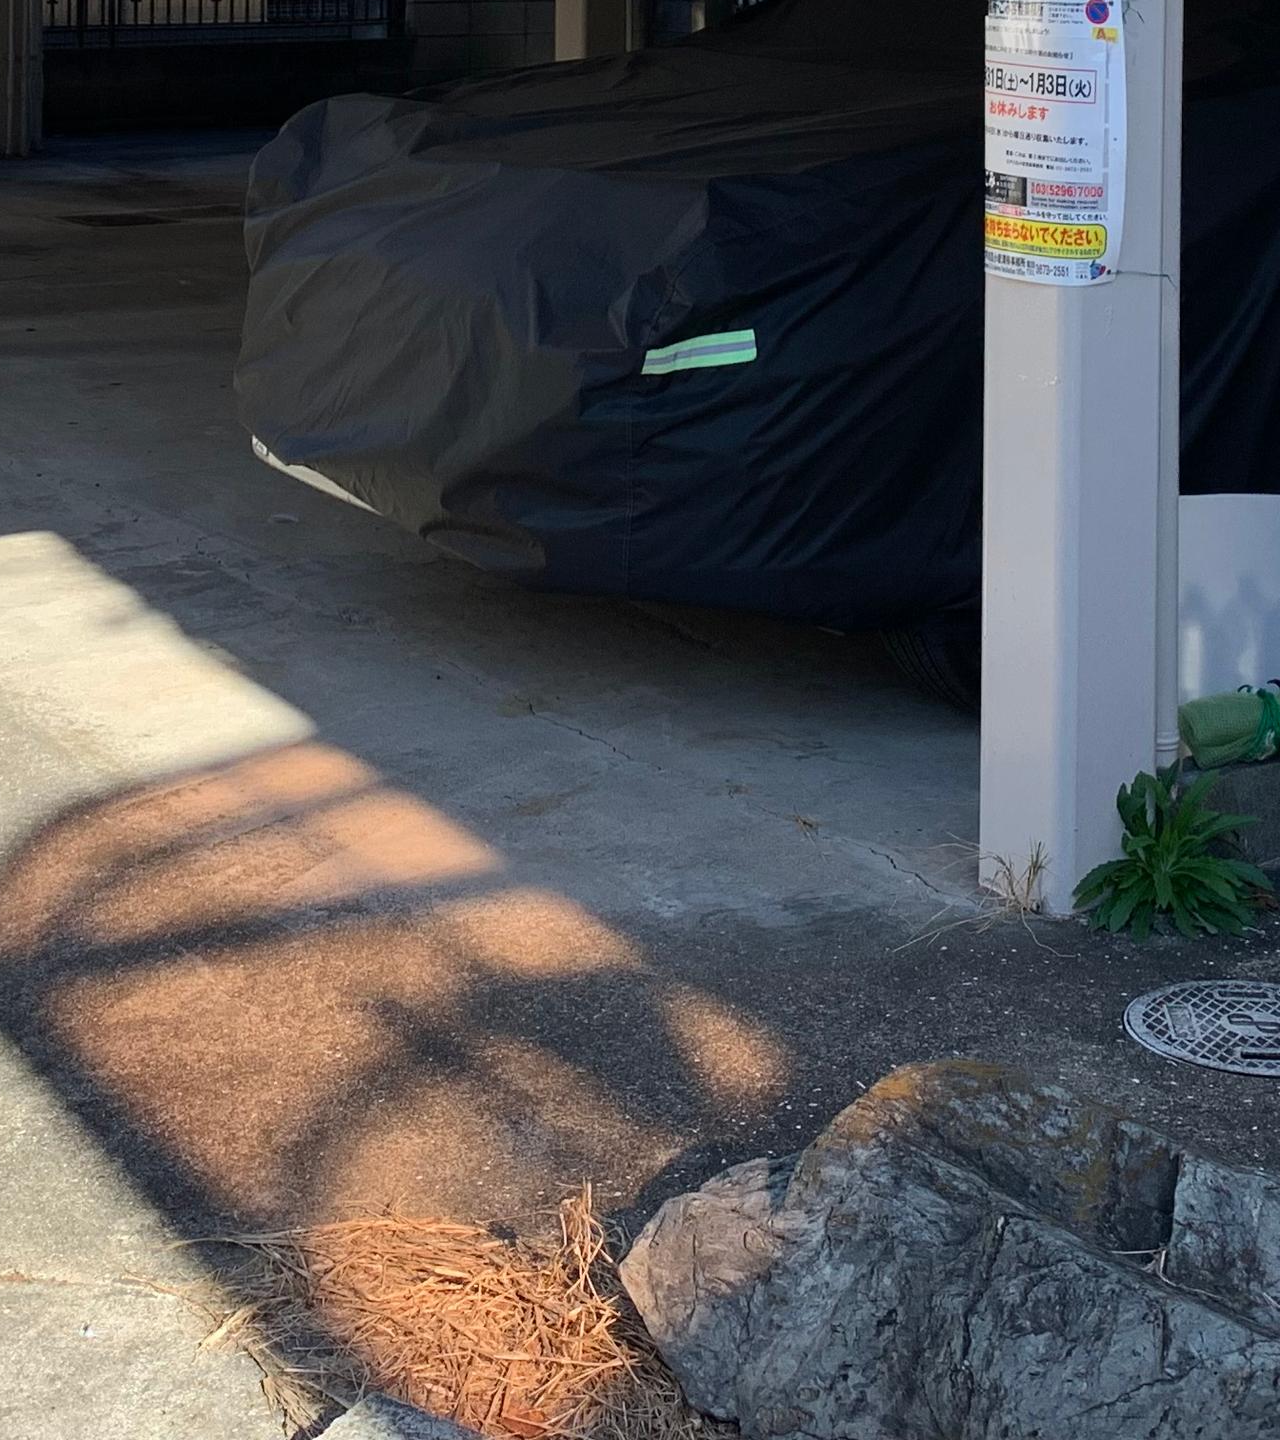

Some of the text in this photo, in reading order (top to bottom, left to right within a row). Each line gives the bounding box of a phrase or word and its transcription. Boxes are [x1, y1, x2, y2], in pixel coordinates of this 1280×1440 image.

[989, 101, 1049, 121] お休みします
